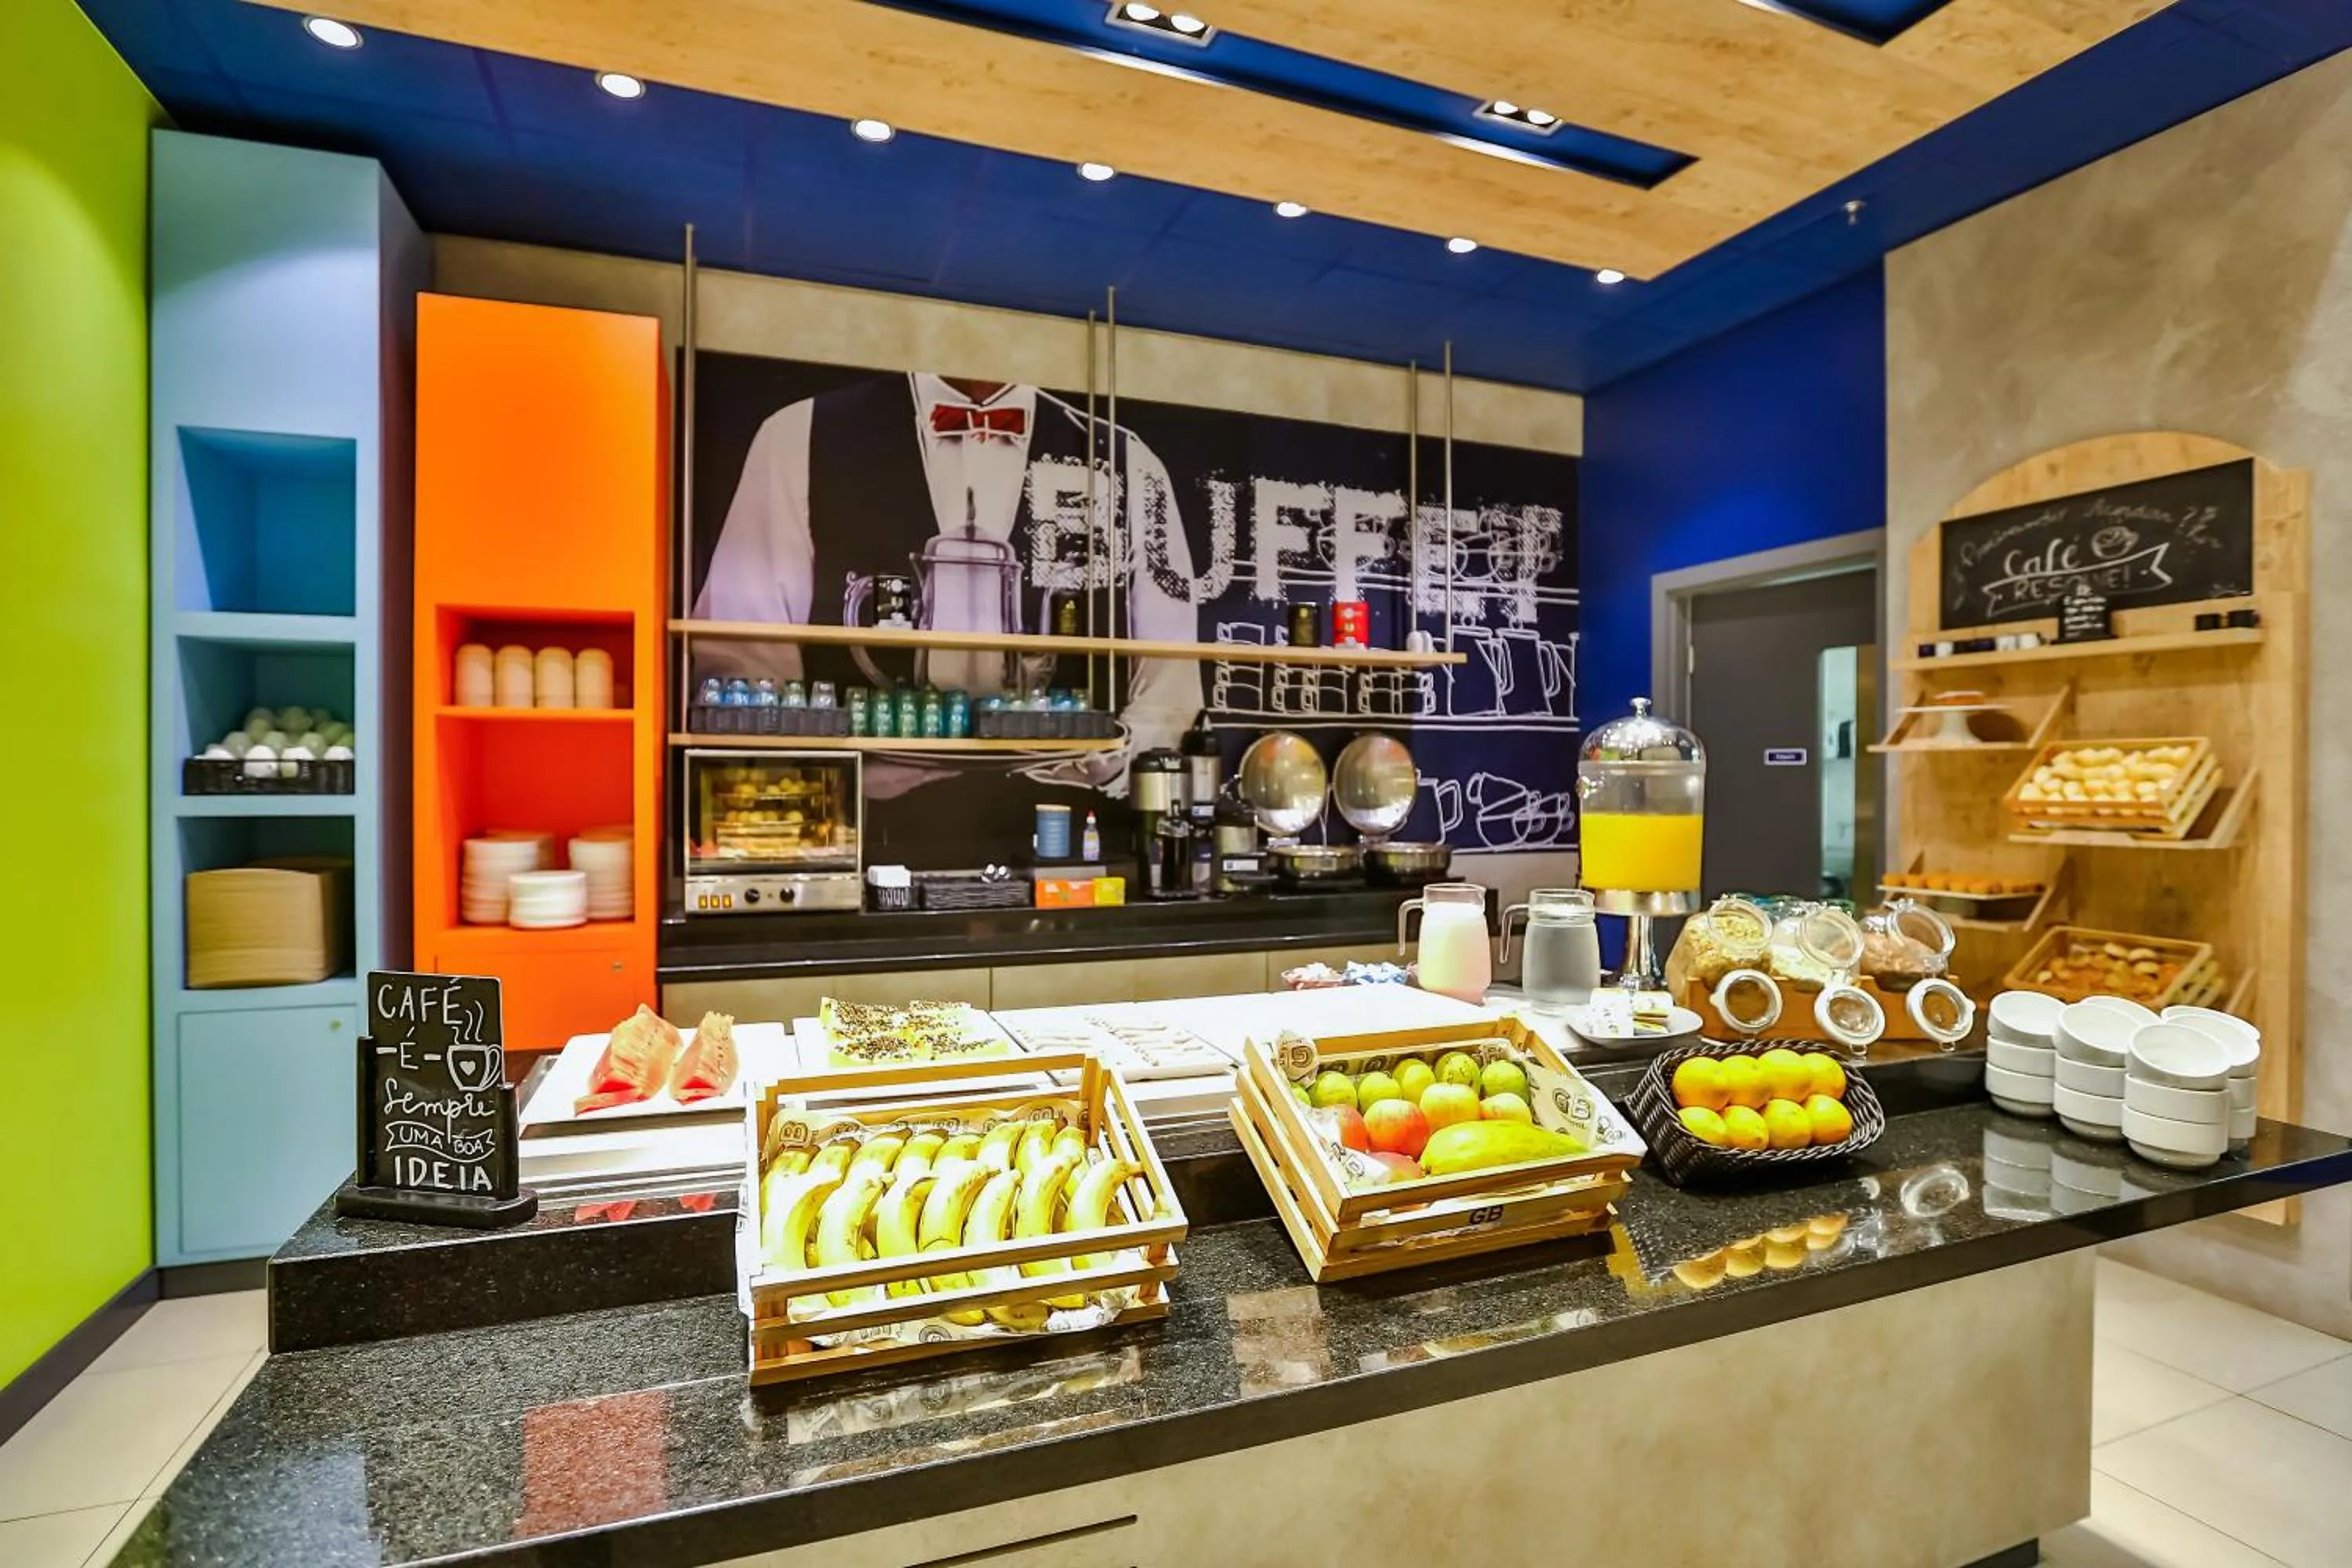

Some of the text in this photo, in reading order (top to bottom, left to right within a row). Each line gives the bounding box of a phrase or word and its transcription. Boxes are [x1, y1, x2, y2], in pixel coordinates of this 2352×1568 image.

[1022, 453, 1563, 623] BUFFET
[2004, 536, 2082, 578] Café
[377, 975, 463, 1025] CAFÉ
[383, 1078, 496, 1144] Sempre
[1552, 1087, 1592, 1120] GB
[398, 1126, 486, 1155] UMA BOA
[394, 1155, 493, 1192] IDEIA
[1468, 1204, 1504, 1225] GB
